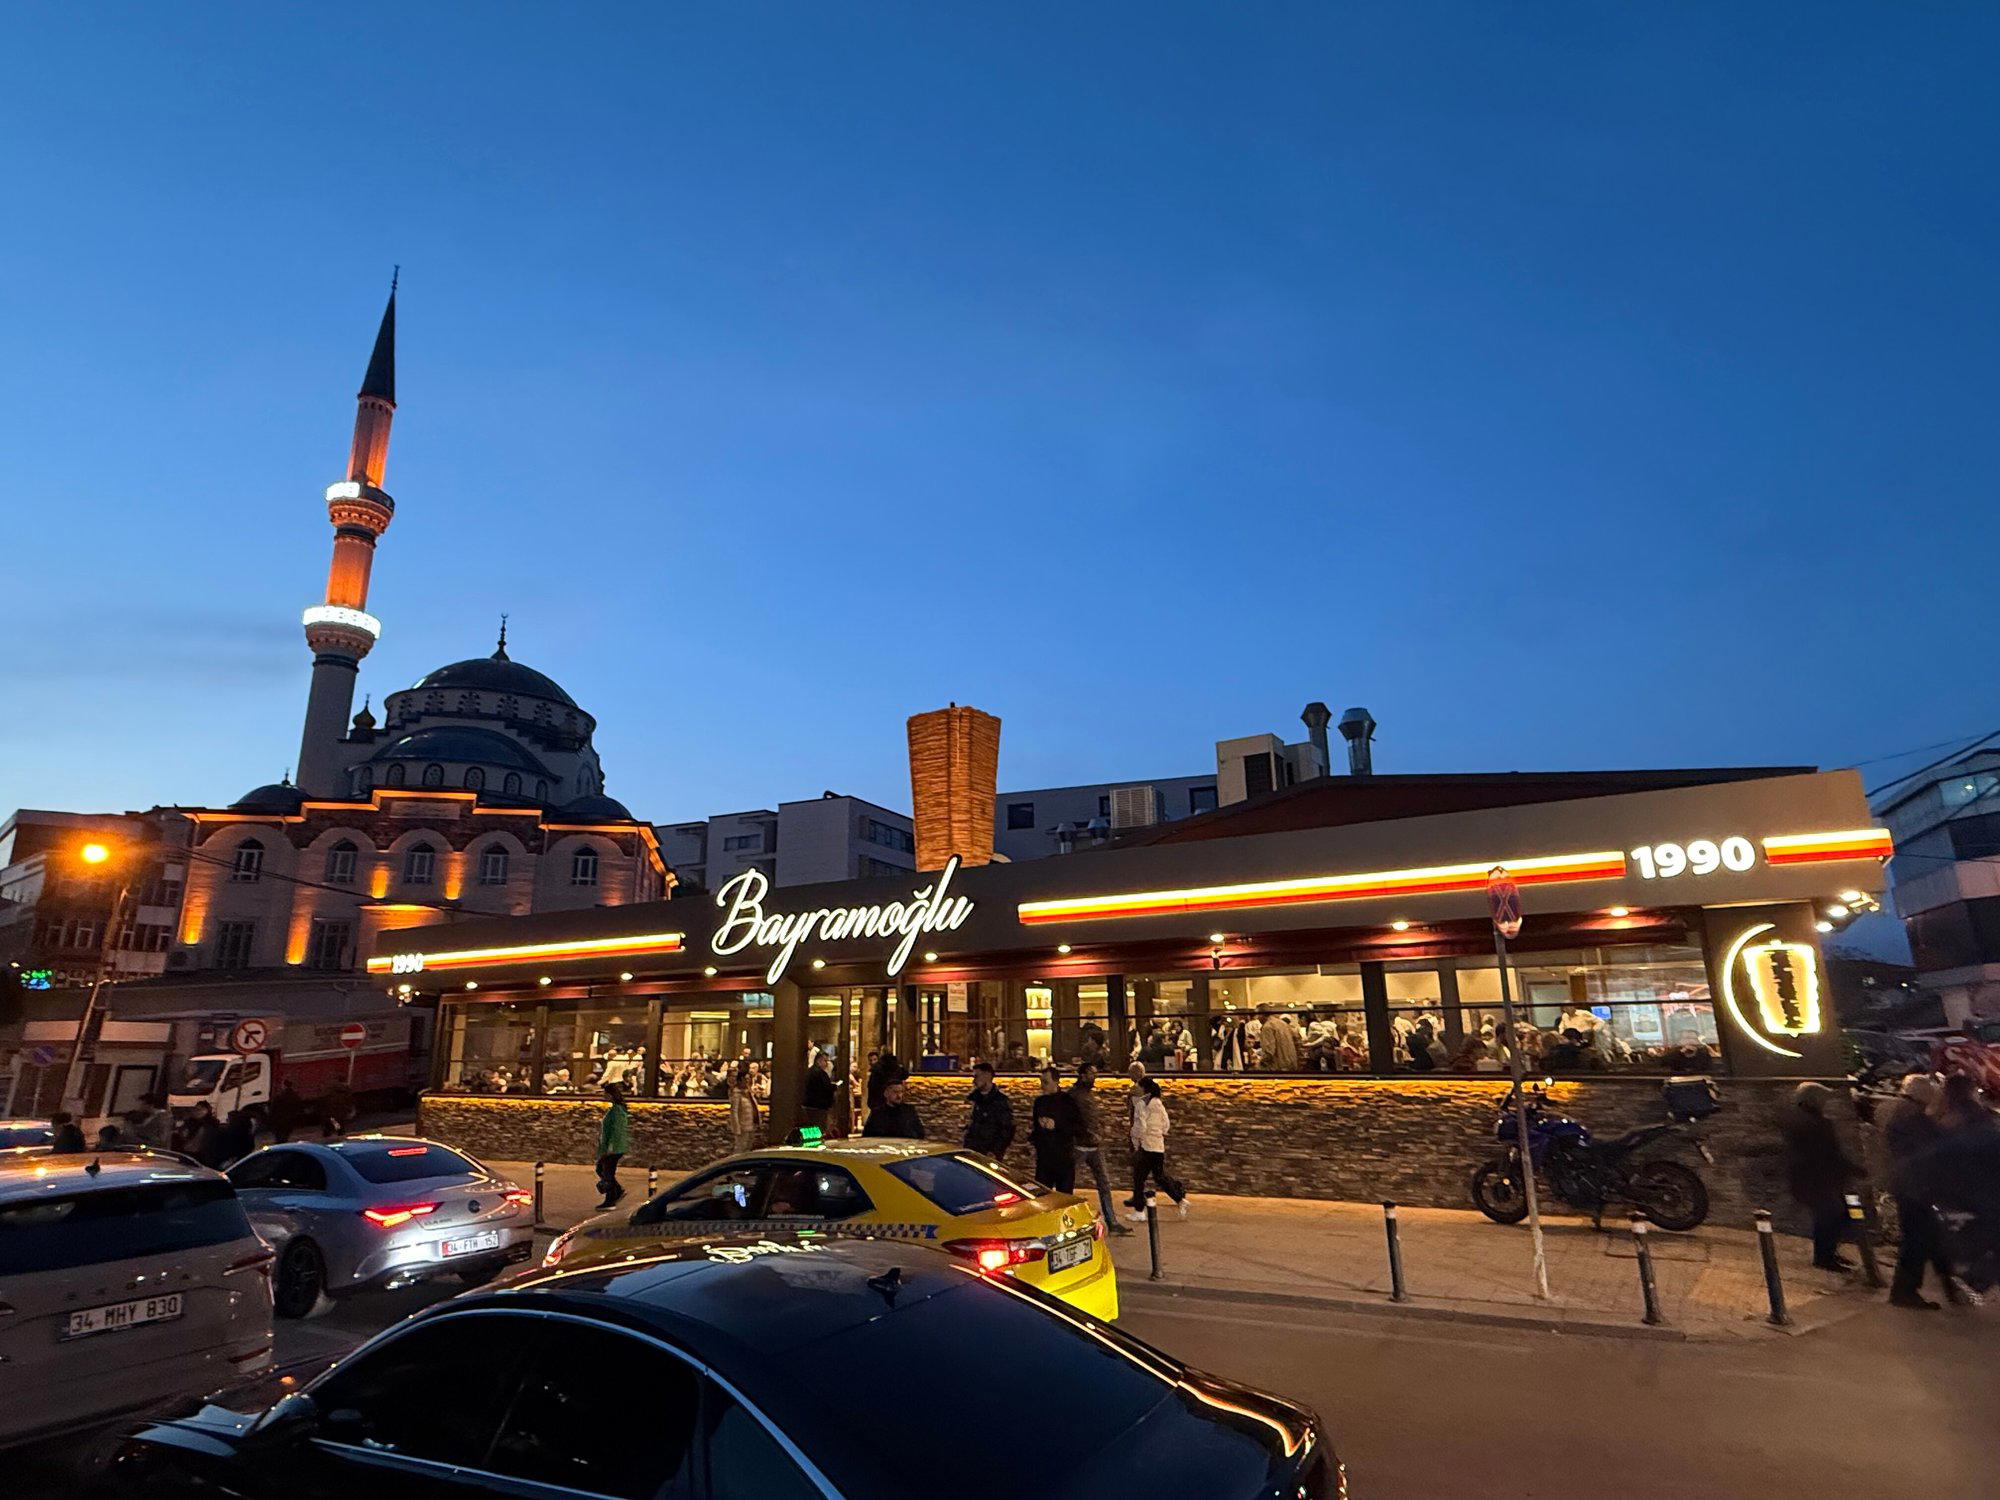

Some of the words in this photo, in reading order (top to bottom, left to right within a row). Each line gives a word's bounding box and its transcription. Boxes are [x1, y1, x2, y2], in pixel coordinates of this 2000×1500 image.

[1630, 836, 1756, 879] 1990
[711, 856, 975, 985] Bayramoğlu
[72, 1312, 93, 1333] 34
[104, 1304, 137, 1327] MHY
[146, 1296, 178, 1319] 830
